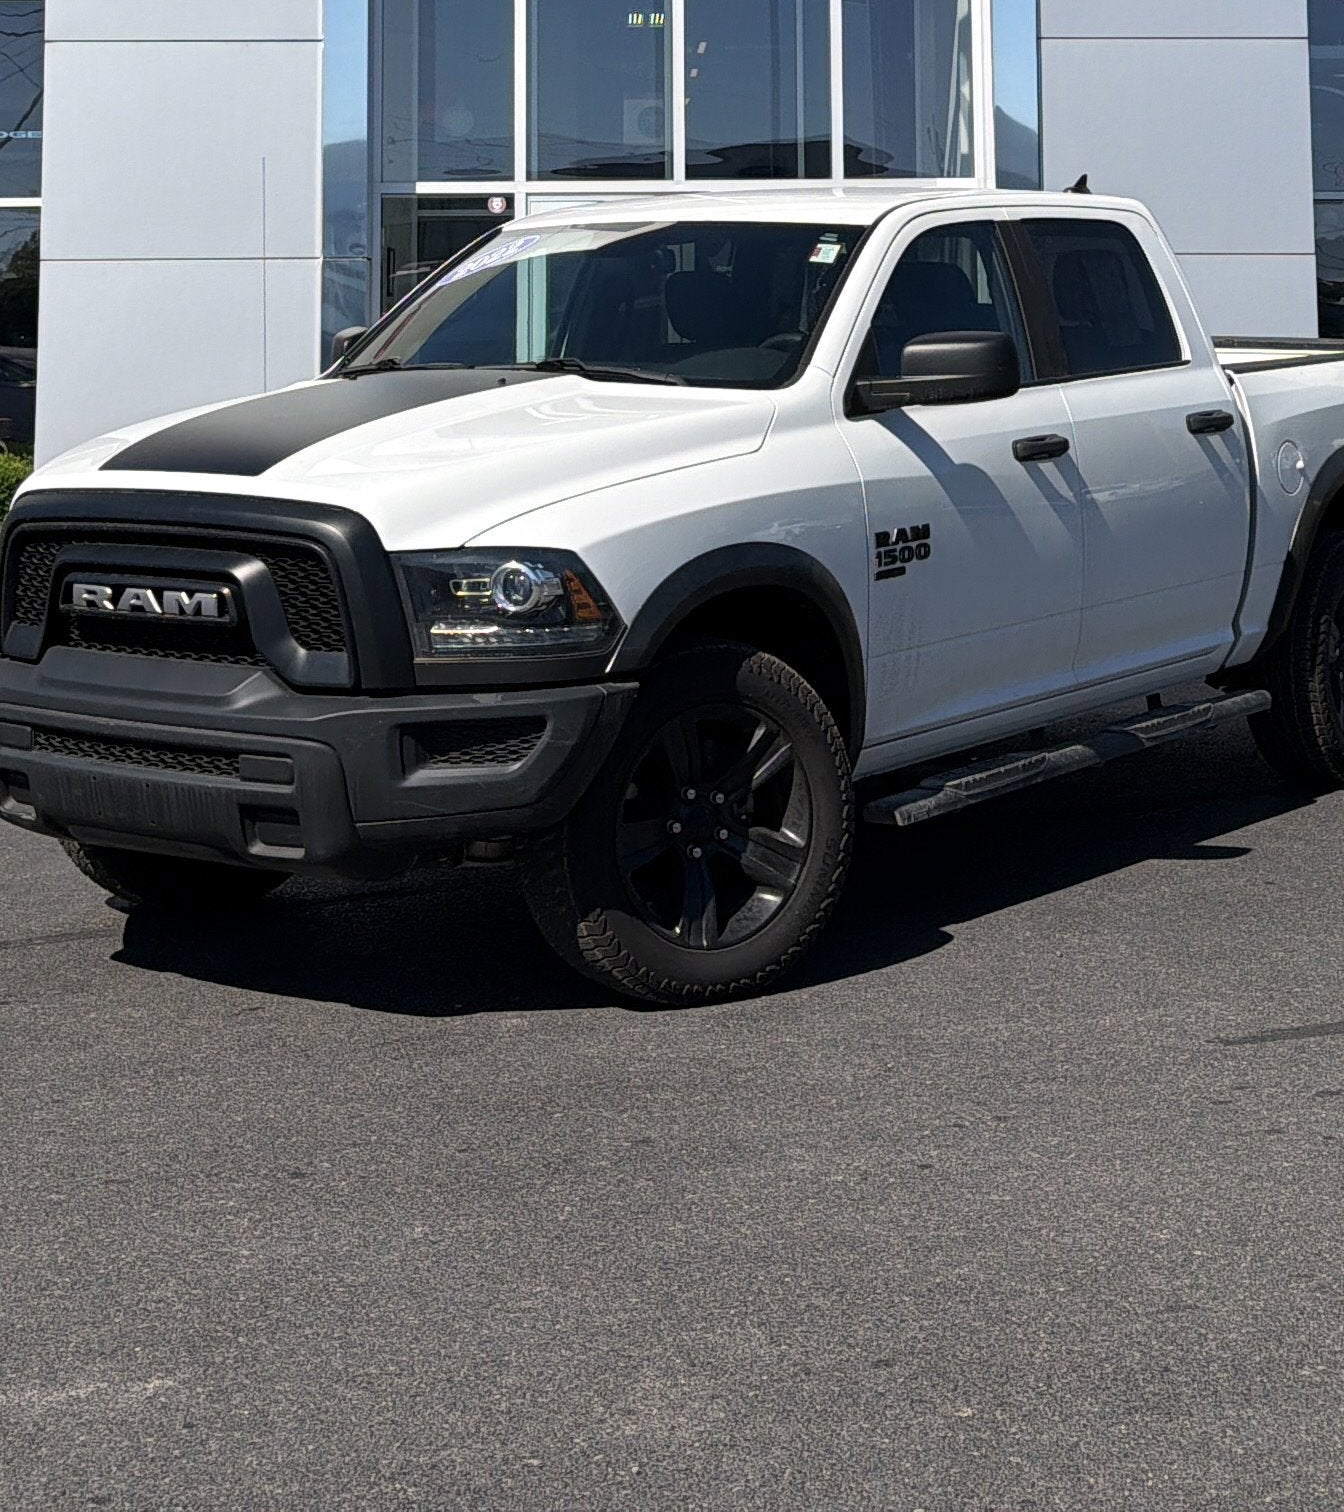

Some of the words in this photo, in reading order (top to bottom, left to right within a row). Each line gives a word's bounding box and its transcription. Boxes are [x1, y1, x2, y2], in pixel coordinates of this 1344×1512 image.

[874, 522, 931, 549] RAM
[875, 542, 931, 568] 1500
[72, 583, 219, 618] RAM
